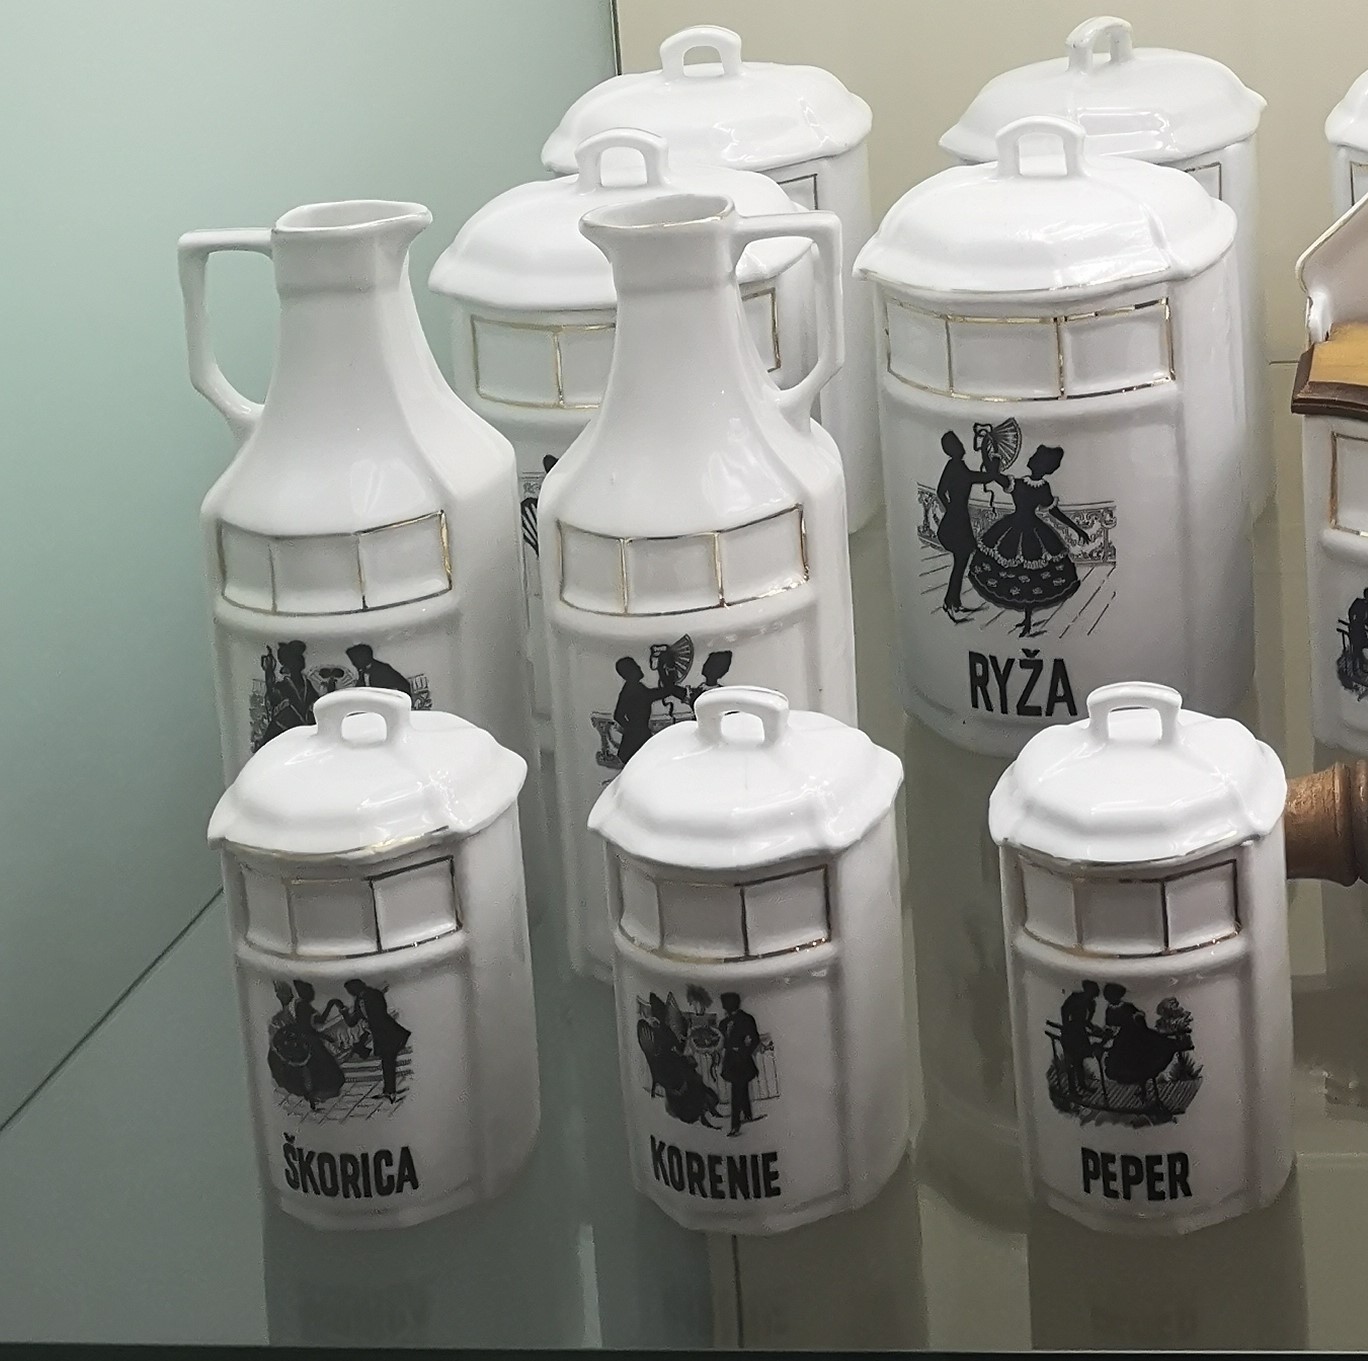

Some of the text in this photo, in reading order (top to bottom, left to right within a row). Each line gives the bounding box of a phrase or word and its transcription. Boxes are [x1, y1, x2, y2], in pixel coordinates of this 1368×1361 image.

[968, 648, 1079, 717] RYŽA
[282, 1132, 420, 1199] ŠKORICA
[650, 1135, 782, 1200] KORENIE
[1080, 1146, 1194, 1202] PEPER
